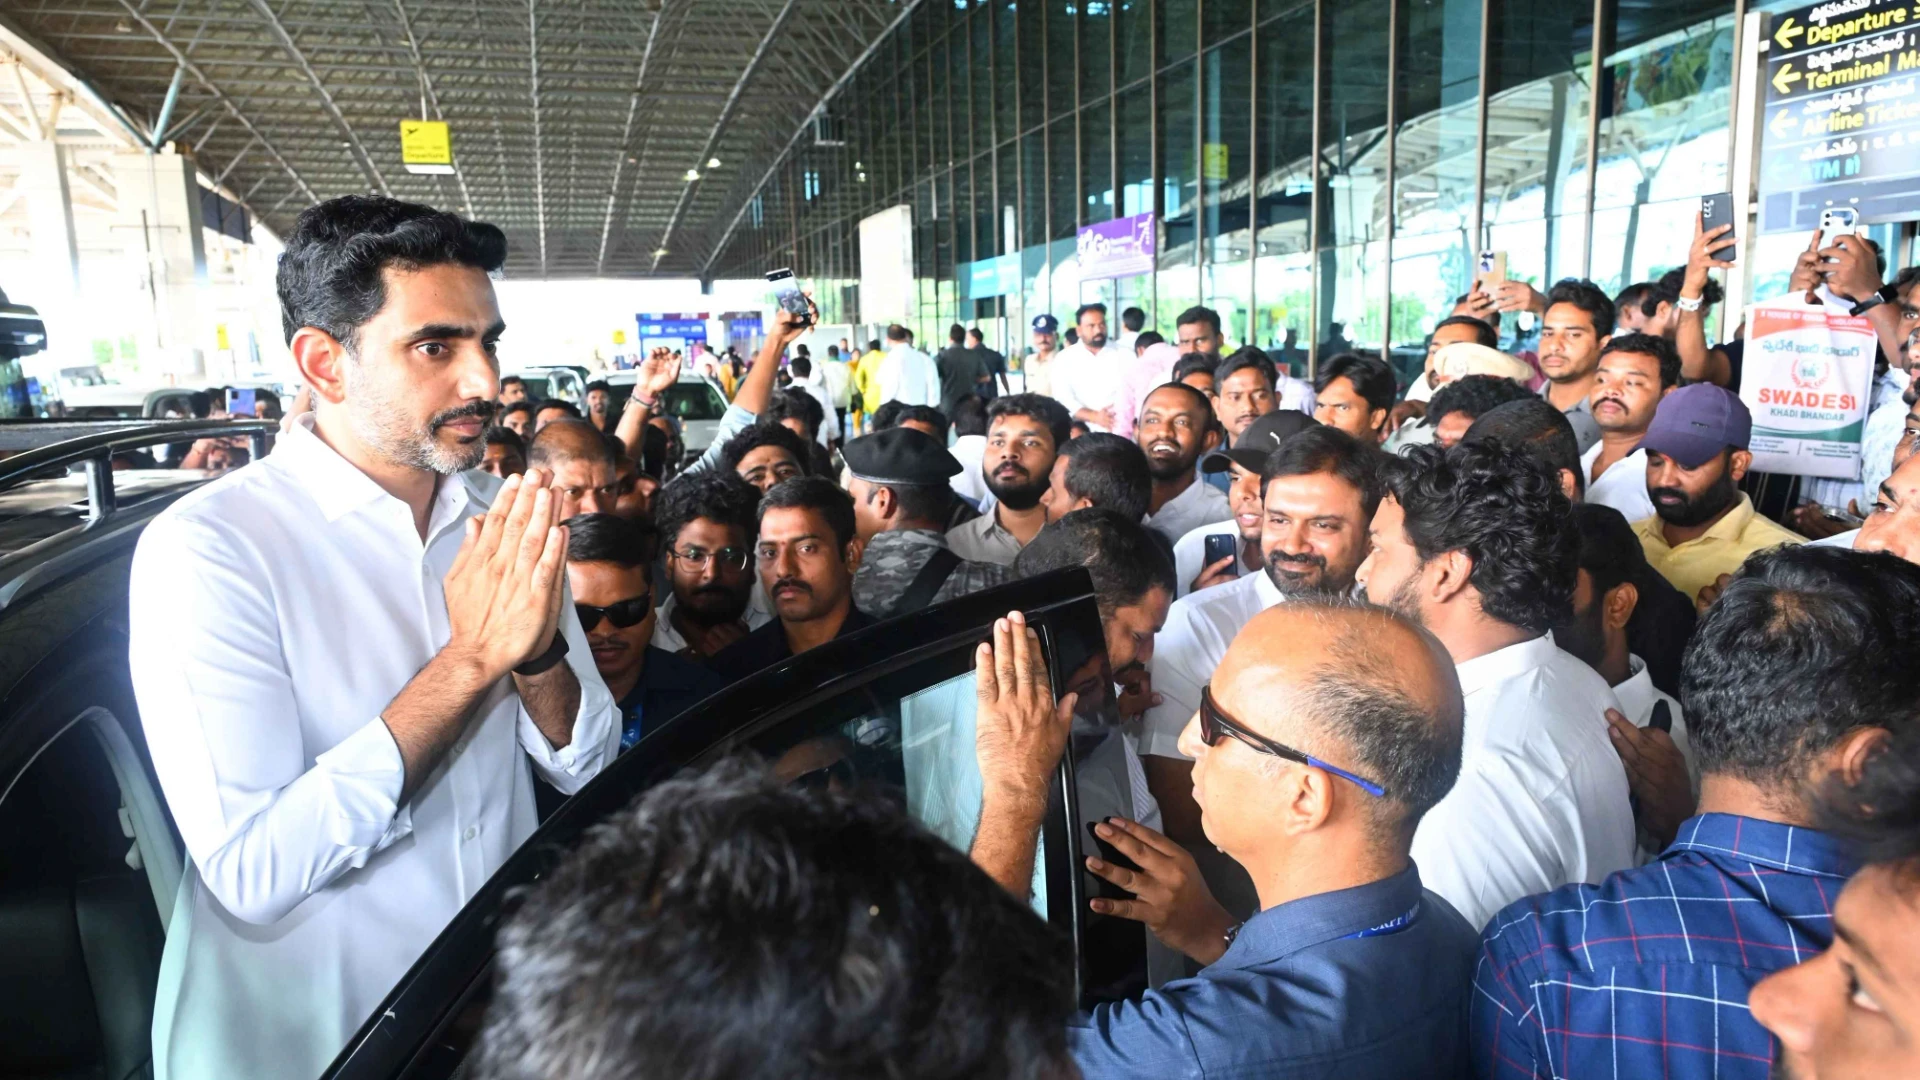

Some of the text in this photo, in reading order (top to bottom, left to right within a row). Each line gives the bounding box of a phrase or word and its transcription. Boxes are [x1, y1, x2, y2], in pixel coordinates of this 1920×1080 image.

[1807, 8, 1907, 45] Departure
[1805, 54, 1890, 90] Terminal
[1803, 110, 1864, 136] Airline
[1800, 159, 1840, 181] ATM
[1758, 388, 1856, 411] SWADESI
[1770, 408, 1845, 422] KHADI BHANDAR
